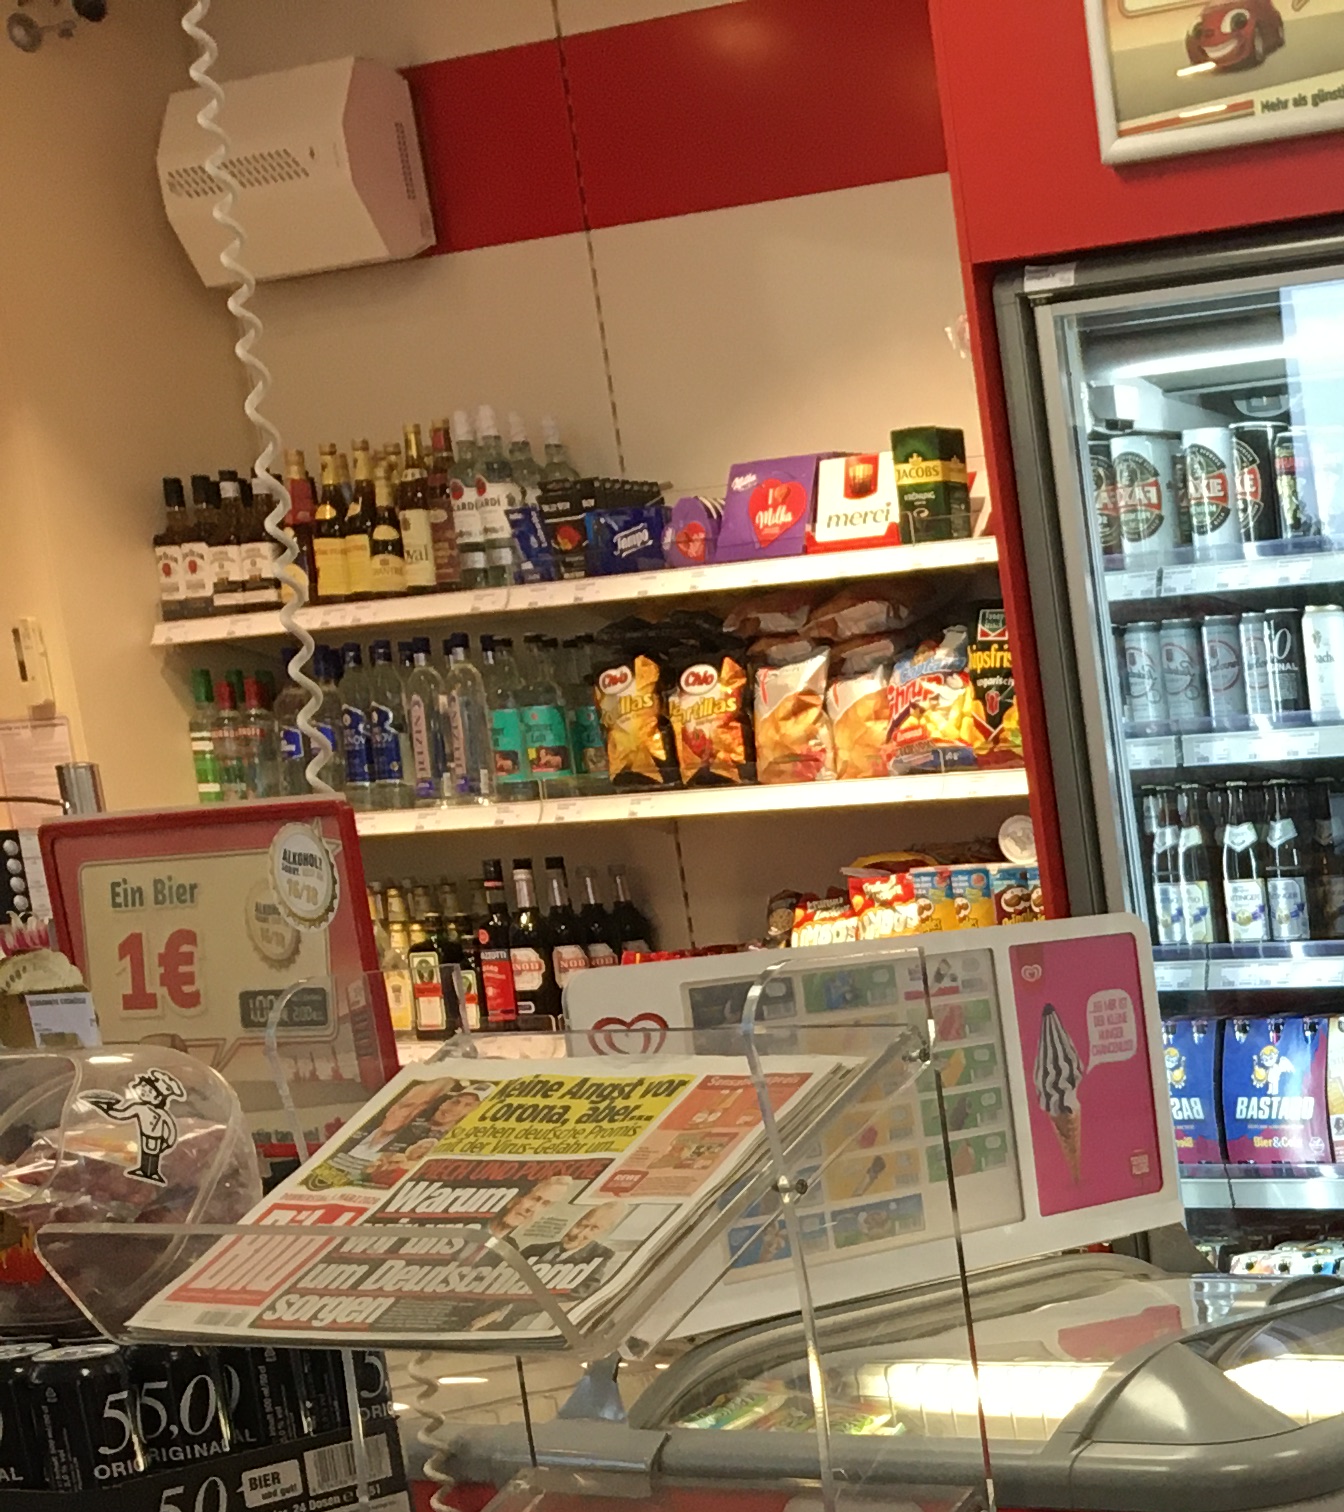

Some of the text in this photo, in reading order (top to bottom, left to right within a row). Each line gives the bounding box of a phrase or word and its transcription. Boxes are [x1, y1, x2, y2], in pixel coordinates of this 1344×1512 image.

[1260, 97, 1289, 113] Mehr
[1292, 93, 1308, 106] als
[896, 465, 940, 482] JACOBS
[755, 508, 793, 528] Milka
[827, 503, 891, 528] merci
[685, 671, 714, 688] Chio
[110, 876, 198, 909] Ein Bier
[117, 928, 202, 1012] 1€
[558, 1077, 638, 1101] Angst
[641, 1079, 690, 1099] vor
[478, 1100, 654, 1126] Corona, aber...
[463, 1122, 643, 1142] gehen deutsche Promis
[462, 1138, 587, 1154] der Virus-Gefahr
[478, 1160, 604, 1181] UND PORSCHE
[384, 1181, 518, 1214] Warum
[298, 1262, 364, 1290] um
[264, 1295, 396, 1326] sorgen
[248, 1471, 282, 1492] BIER
[309, 1494, 341, 1512] Dosen
